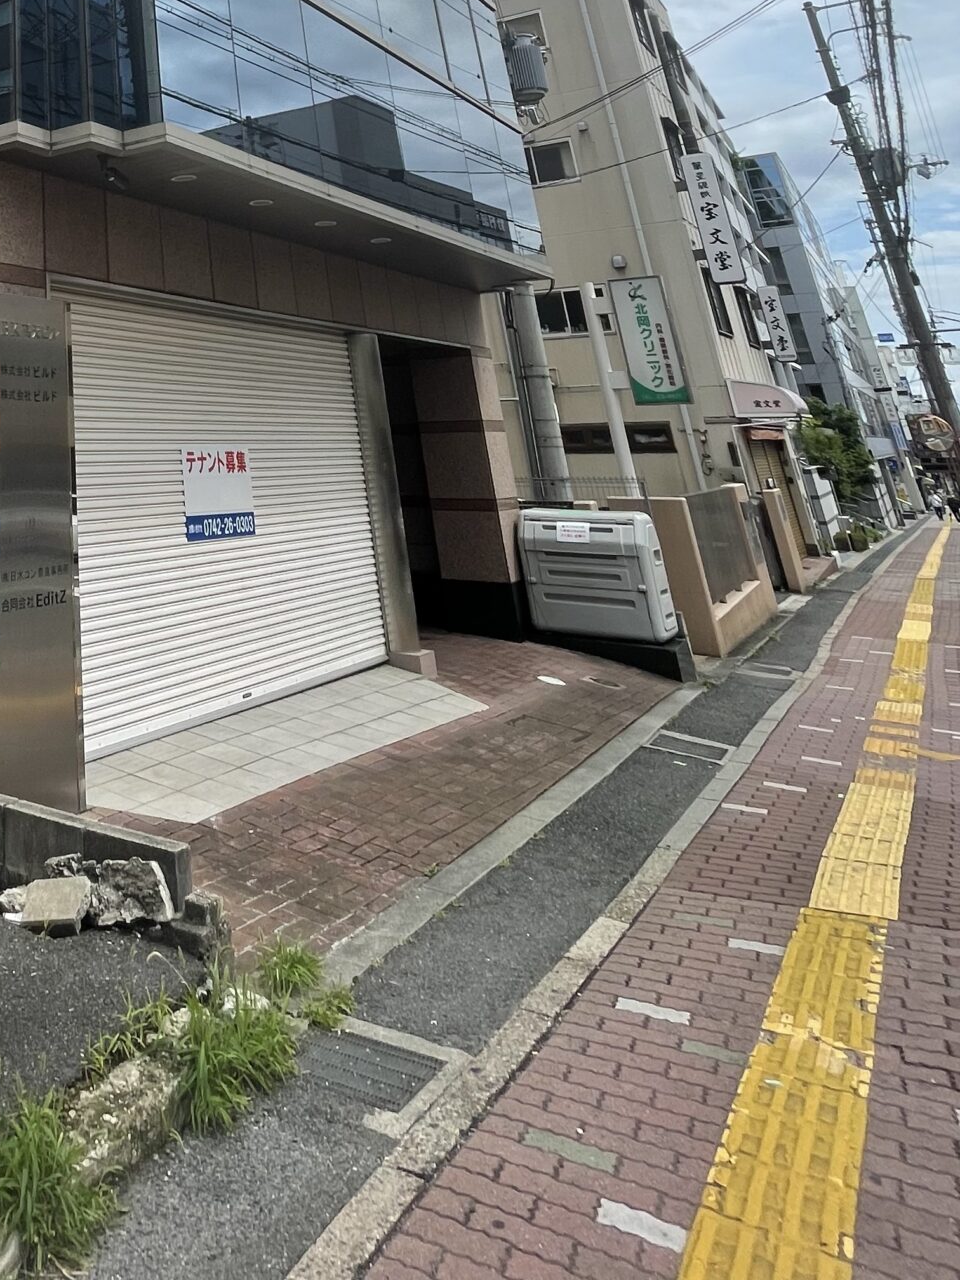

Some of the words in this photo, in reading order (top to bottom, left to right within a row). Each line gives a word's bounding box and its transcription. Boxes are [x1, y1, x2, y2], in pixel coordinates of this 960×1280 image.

[700, 201, 733, 271] 宝文堂
[186, 450, 247, 474] テナント募集
[203, 515, 254, 536] 0742-26-0303
